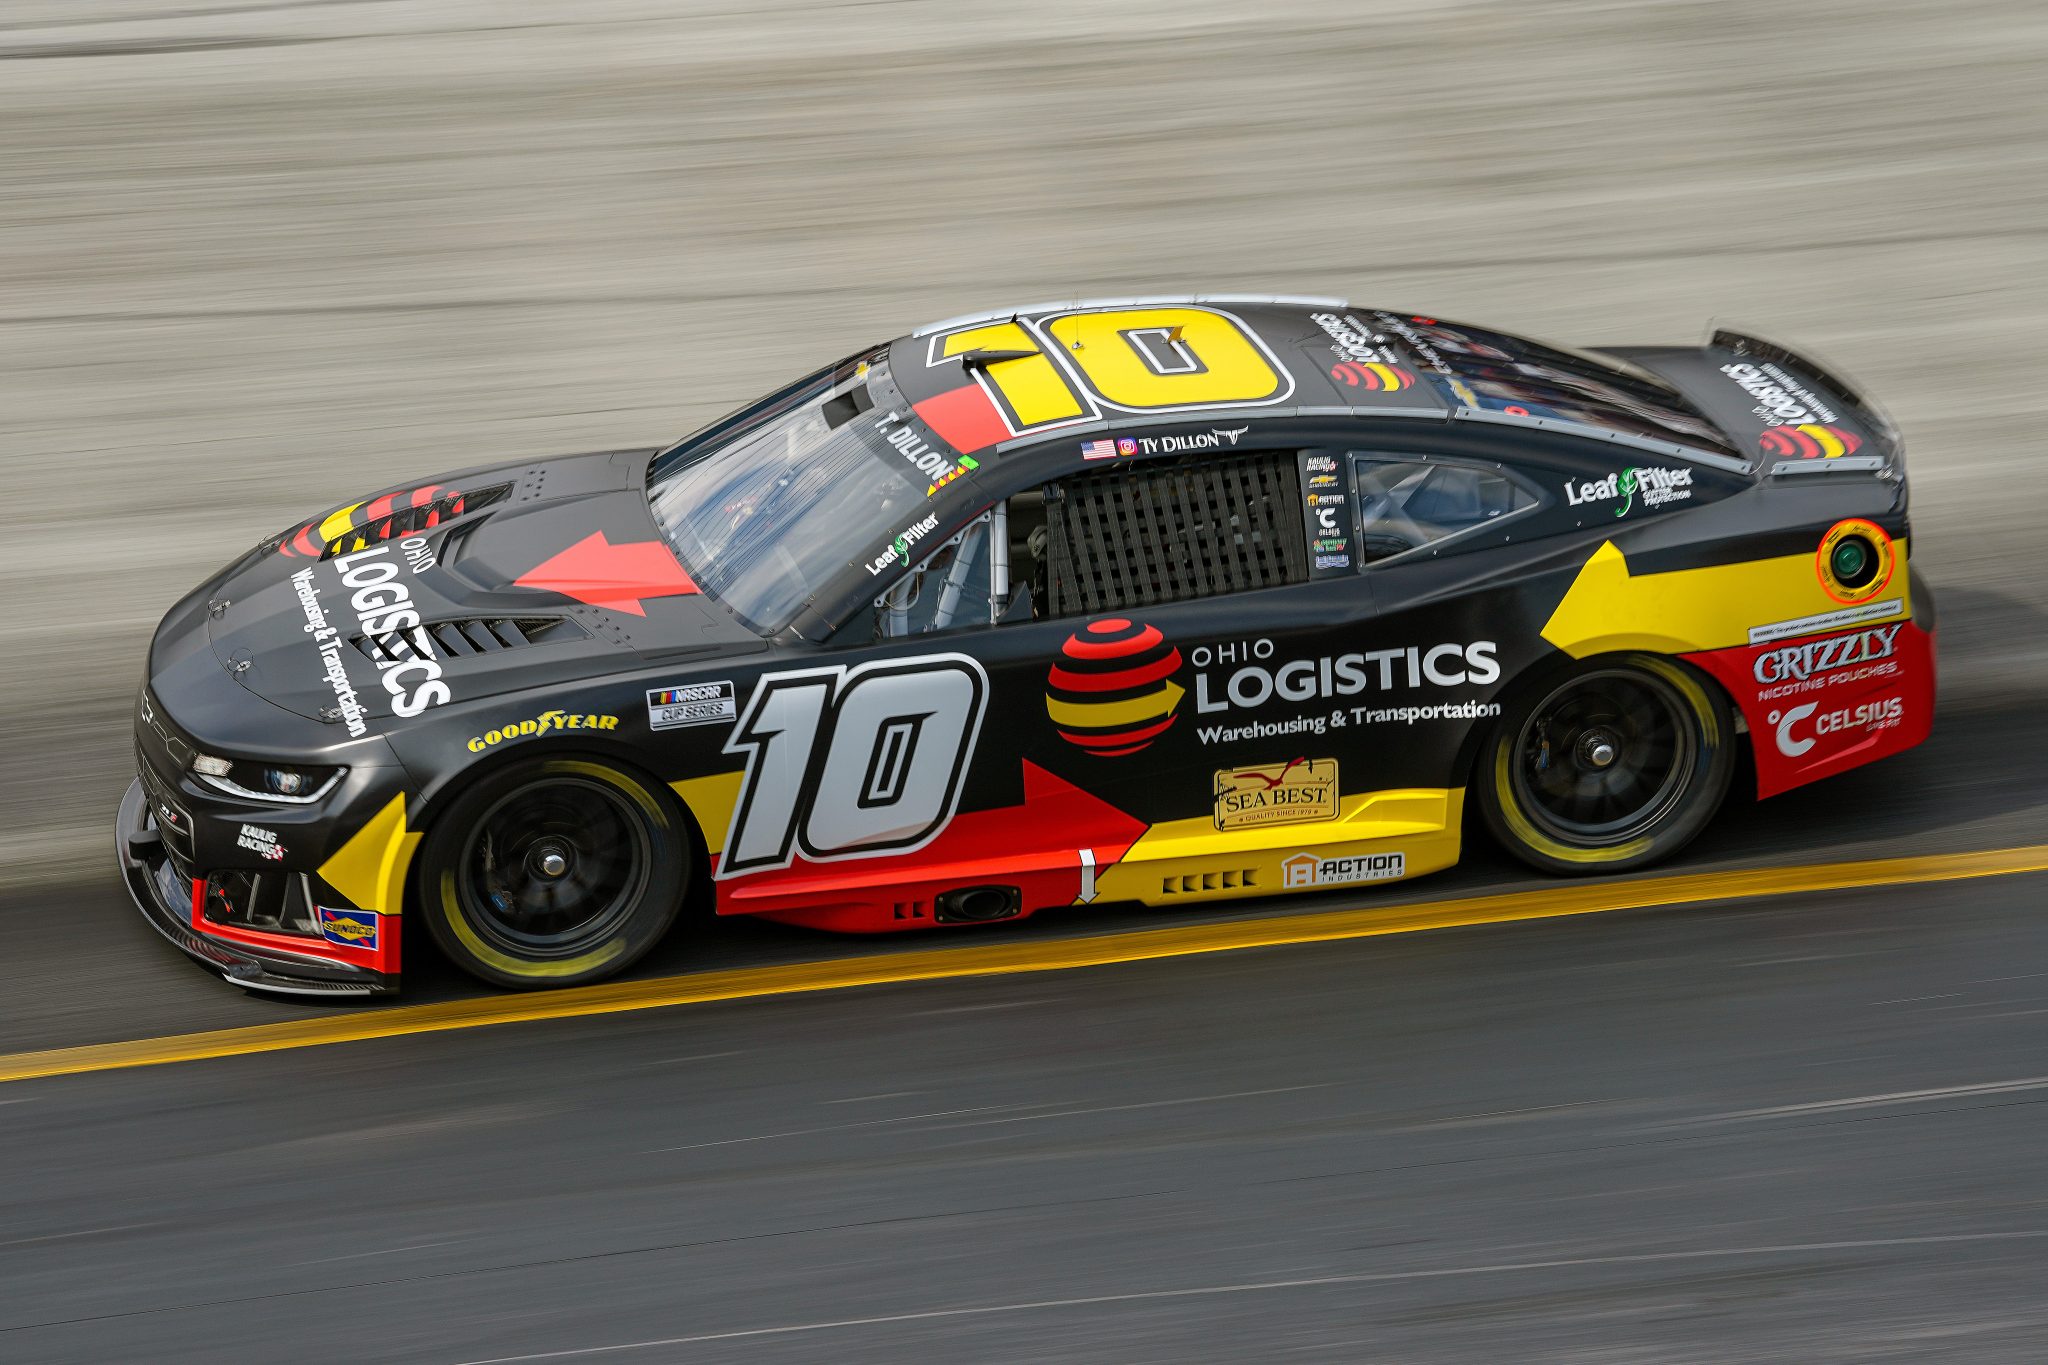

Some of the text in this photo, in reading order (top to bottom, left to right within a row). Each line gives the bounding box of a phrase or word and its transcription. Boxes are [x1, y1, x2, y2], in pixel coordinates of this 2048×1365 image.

[926, 306, 1296, 437] 10
[874, 411, 955, 481] T. DILLON
[1138, 433, 1220, 454] TY DILLON
[1564, 466, 1693, 506] Leaf Filter
[400, 537, 436, 574] OHIO
[864, 512, 940, 576] Leaf Filter
[290, 566, 368, 738] Warehousing & Transportation
[1191, 638, 1274, 667] OHIO
[1752, 623, 1904, 684] GRIZZLY
[675, 685, 722, 703] NASCAR
[1195, 641, 1501, 714] LOGISTICS
[1758, 661, 1898, 702] NICOTINE POUCHES
[467, 709, 620, 752] GOODYEAR
[1197, 700, 1501, 745] Warehousing & Transportation
[1816, 697, 1904, 735] CELSIUS
[714, 651, 990, 881] 10
[1226, 787, 1327, 813] SEA BEST
[1245, 811, 1275, 821] QUALITY
[1276, 809, 1296, 817] SINCE
[1319, 854, 1402, 875] ACTION
[1322, 869, 1403, 882] INDUSTRIES
[324, 921, 375, 937] SUNOCO
